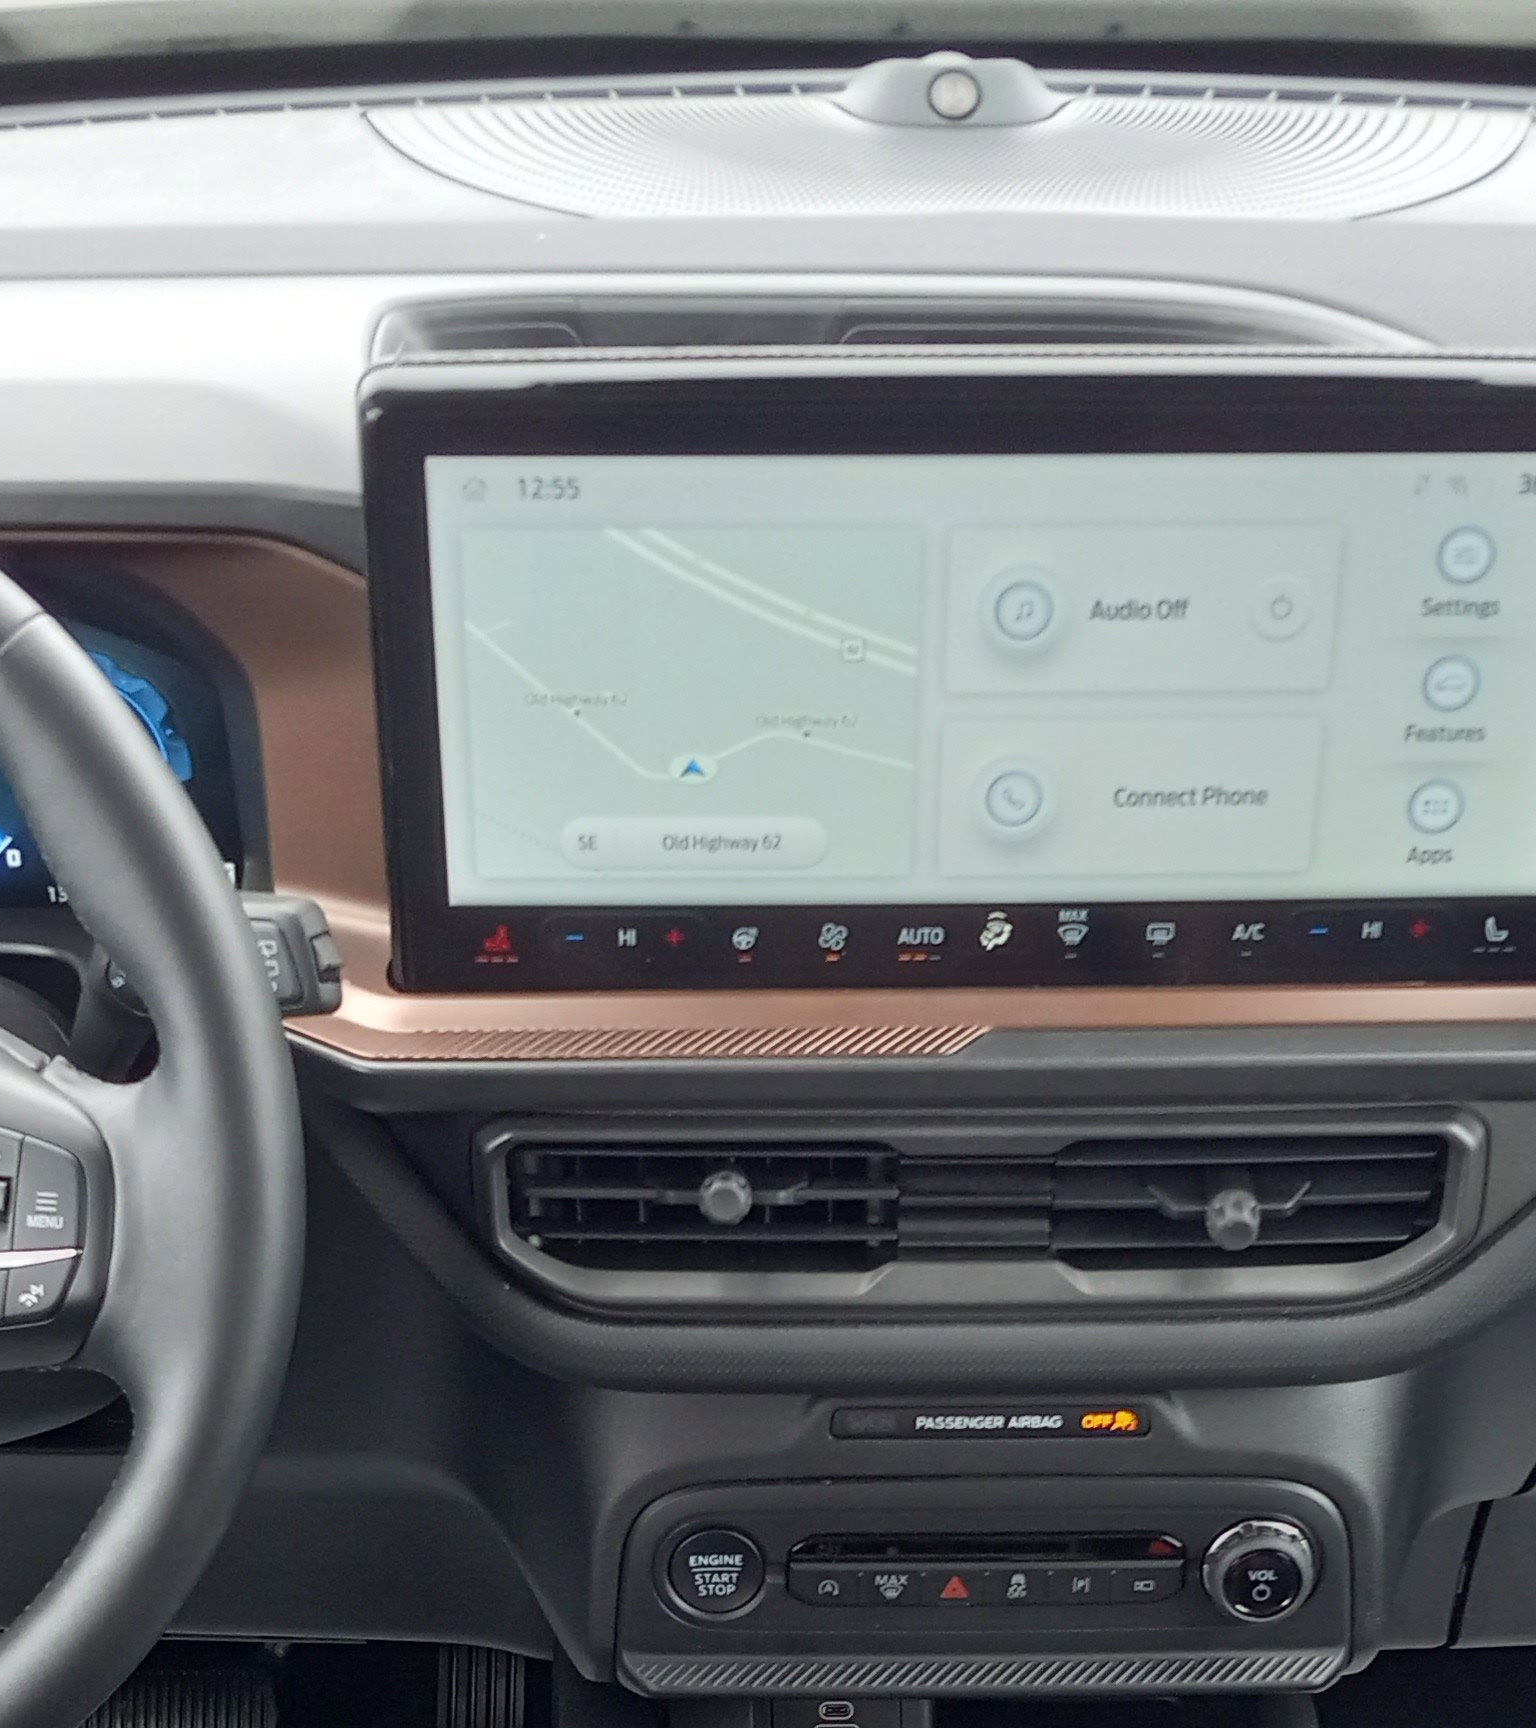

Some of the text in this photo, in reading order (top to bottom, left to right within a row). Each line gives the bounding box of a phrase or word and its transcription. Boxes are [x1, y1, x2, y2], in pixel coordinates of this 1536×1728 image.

[518, 477, 580, 500] 12:55
[1089, 597, 1190, 620] Audio Off
[1421, 597, 1500, 618] Settings
[1404, 724, 1486, 743] Features
[1113, 787, 1268, 807] Connect Phone
[578, 835, 781, 856] SE Old Highway 62
[5, 849, 22, 868] 0
[1406, 845, 1453, 866] Apps
[1059, 910, 1088, 922] MAX
[618, 928, 637, 947] HI
[898, 927, 946, 946] AUTO
[1232, 923, 1265, 941] A/C
[1361, 921, 1383, 939] HI
[26, 1215, 64, 1230] MENU
[915, 1413, 1114, 1430] PASSENGER AIRBAG OFF
[688, 1554, 744, 1567] ENGINE
[694, 1572, 740, 1586] START
[874, 1574, 909, 1586] MAX
[1247, 1569, 1278, 1582] VOL
[697, 1584, 737, 1597] STOP
